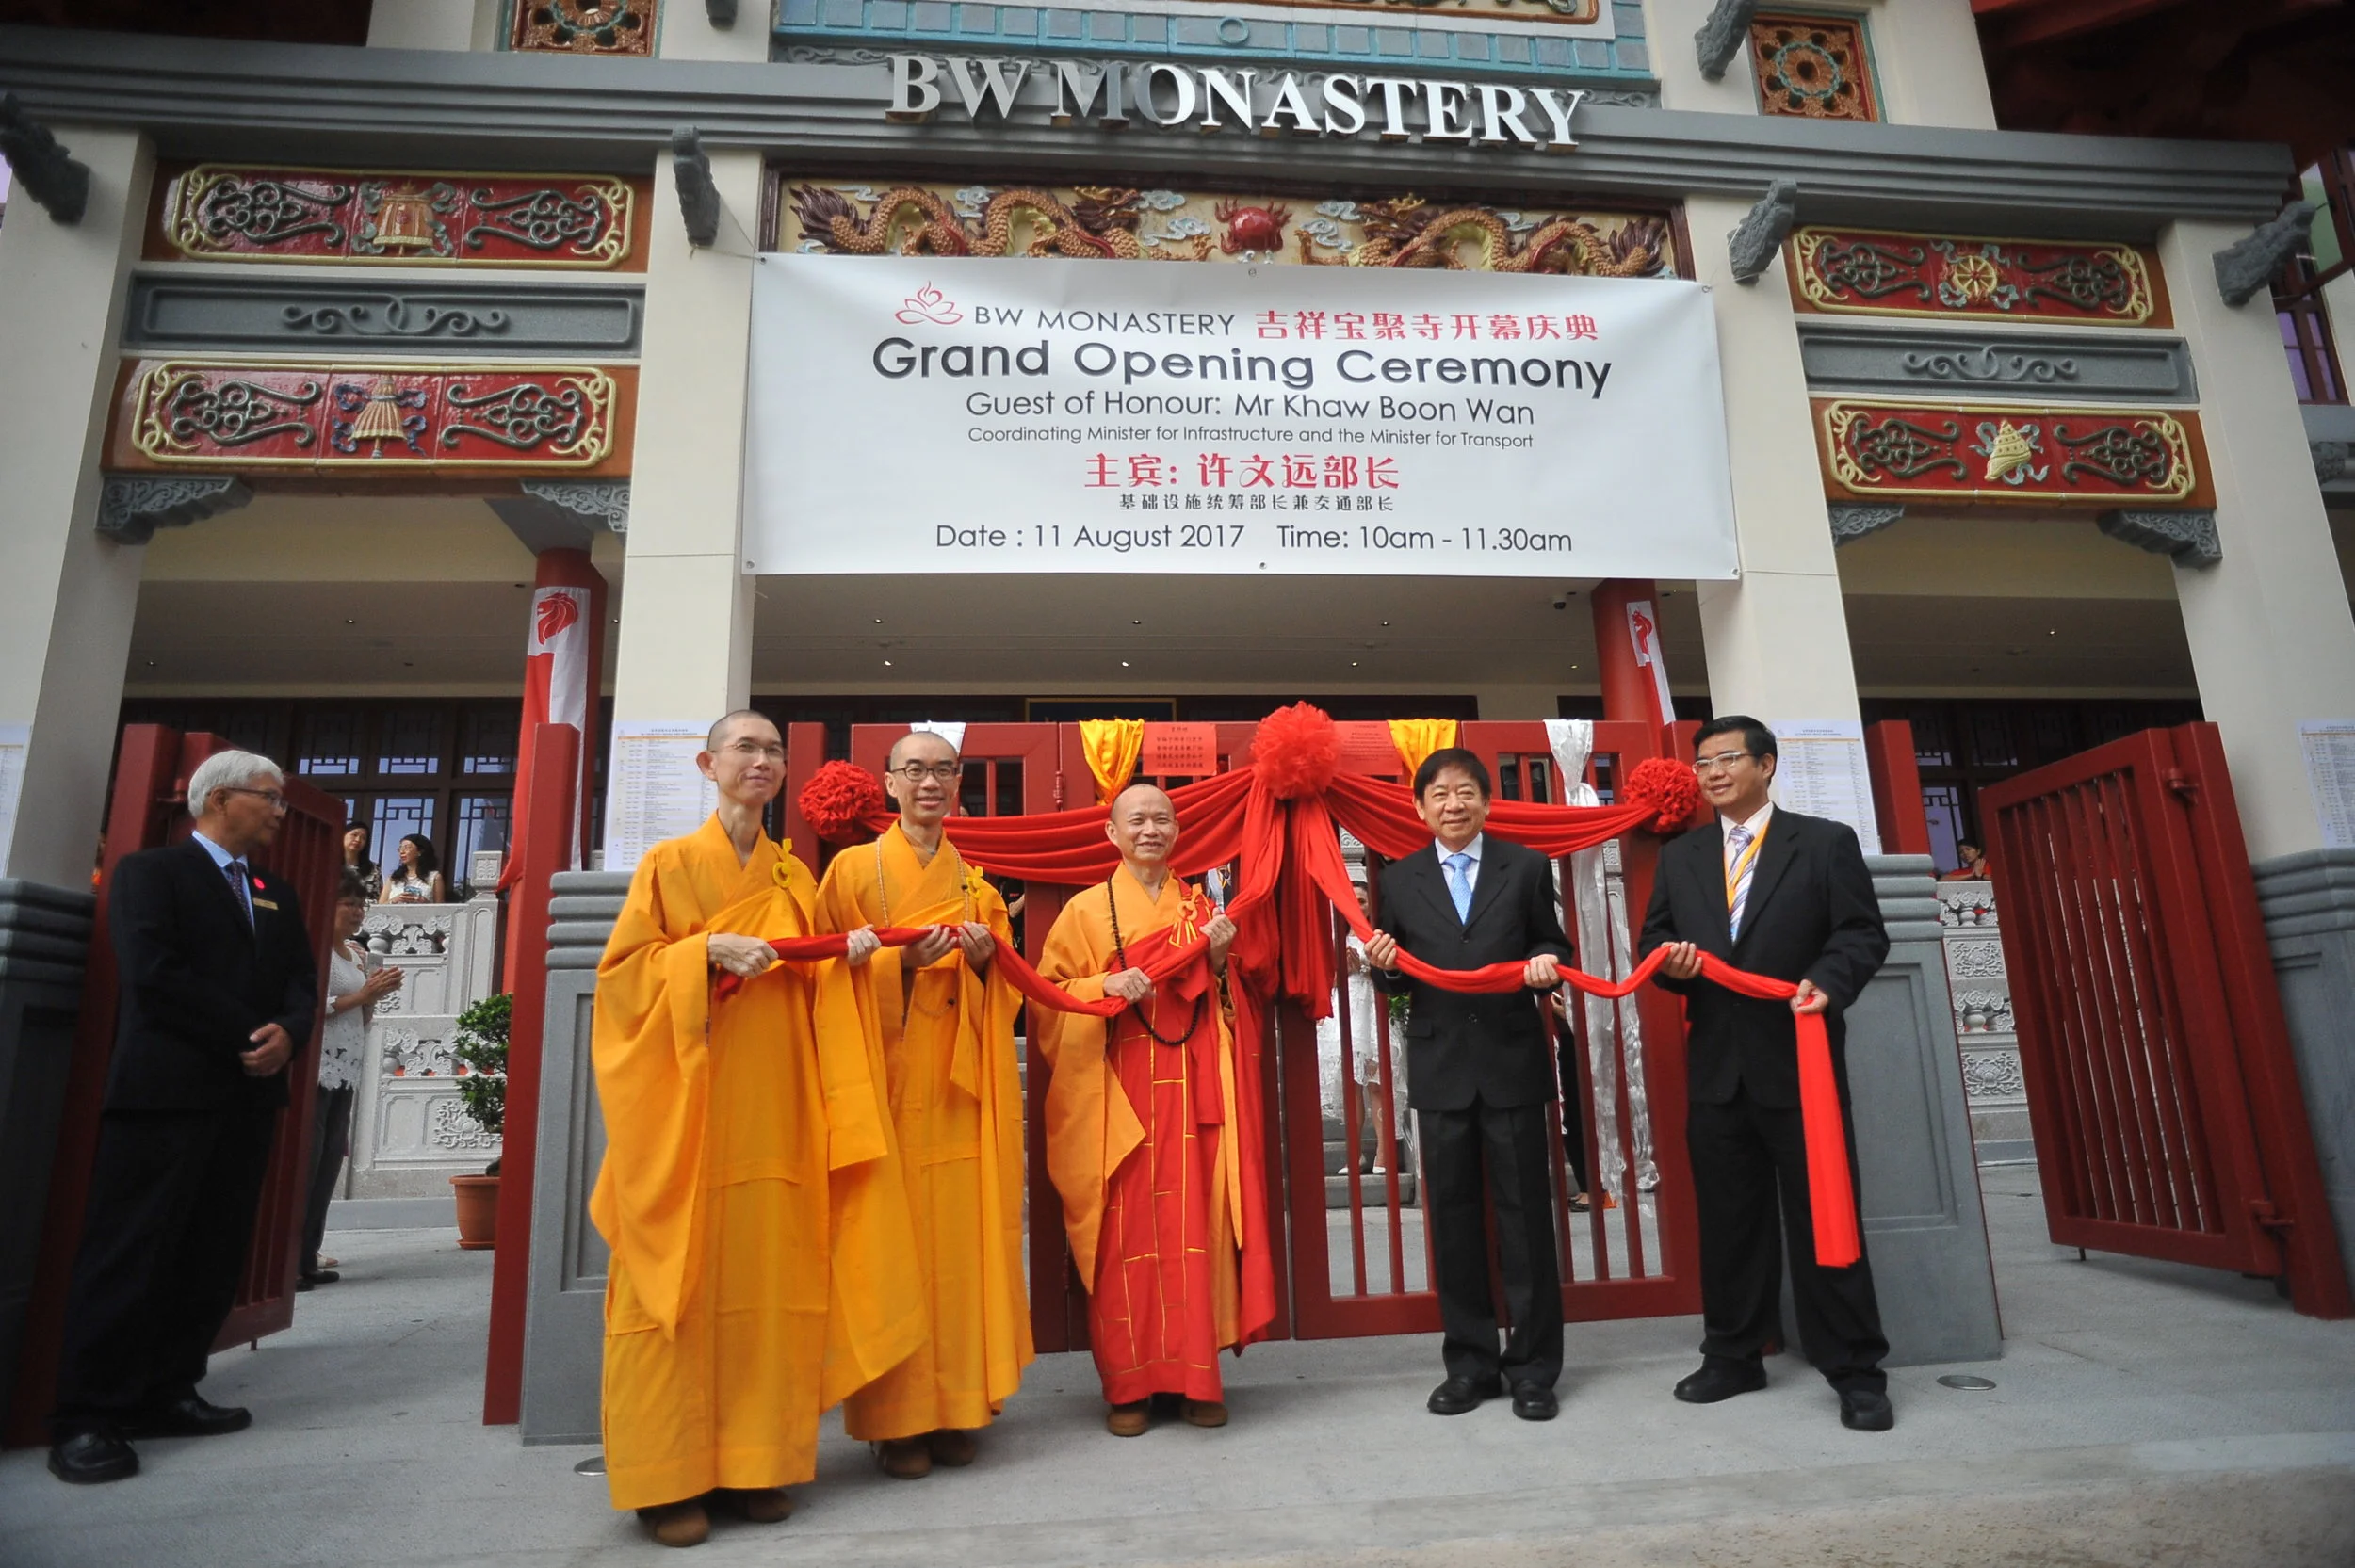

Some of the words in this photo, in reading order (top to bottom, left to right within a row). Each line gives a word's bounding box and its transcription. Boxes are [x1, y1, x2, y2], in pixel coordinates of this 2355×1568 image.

[886, 53, 1031, 121] BW
[1050, 60, 1586, 147] MONASTERY
[975, 306, 1024, 326] BW
[1037, 310, 1235, 336] MONASTERY
[1256, 310, 1599, 341] 吉祥宝聚寺开幕庆典
[872, 336, 1049, 380] Grand
[1073, 342, 1314, 391] Opening
[1336, 349, 1613, 400] Ceremony
[966, 390, 1056, 416] Guest
[1064, 389, 1096, 415] of
[1104, 390, 1221, 415] Honour:
[1234, 393, 1275, 417] Mr
[1283, 394, 1371, 419] Khaw
[1379, 396, 1456, 422] Boon
[1465, 397, 1535, 426] Wan
[967, 426, 1082, 445] Coordinating
[1087, 425, 1152, 441] Minister
[1156, 425, 1179, 441] for
[1183, 425, 1294, 442] Infrastructure
[1298, 428, 1333, 443] and
[1338, 428, 1365, 444] the
[1370, 428, 1432, 445] Minister
[1435, 430, 1457, 445] for
[1459, 431, 1534, 450] Transport
[1119, 493, 1393, 512] 基础设施统筹部长兼交通部长
[936, 524, 1007, 547] Date
[1035, 525, 1060, 547] 11
[1073, 524, 1173, 553] August
[1180, 524, 1245, 548] 2017
[1275, 524, 1349, 549] Time:
[1359, 525, 1434, 550] 10am
[1462, 527, 1572, 552] 11.30am
